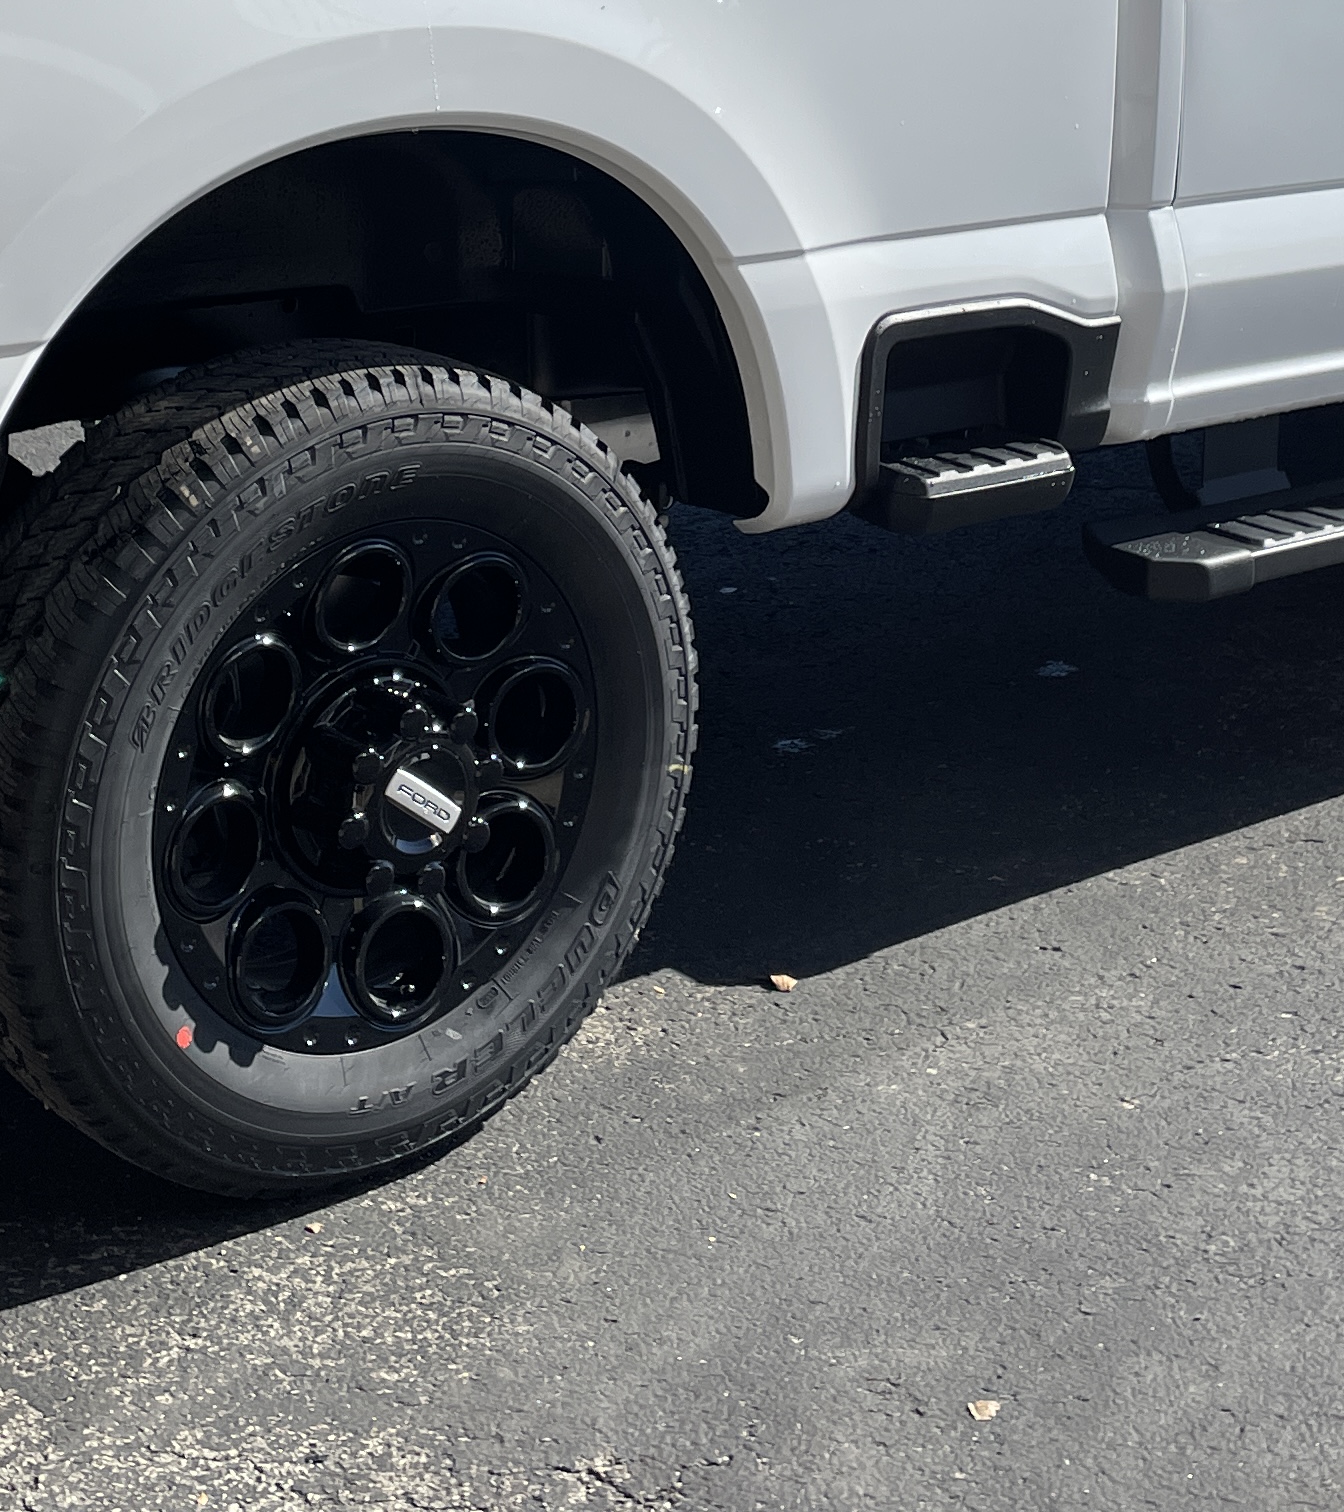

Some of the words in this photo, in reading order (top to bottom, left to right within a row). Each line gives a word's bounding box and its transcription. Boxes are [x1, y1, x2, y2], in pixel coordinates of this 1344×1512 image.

[129, 462, 422, 754] BRIDGESTONE
[397, 784, 451, 821] FORD
[430, 870, 623, 1096] DUELER
[347, 1080, 418, 1118] A/T
